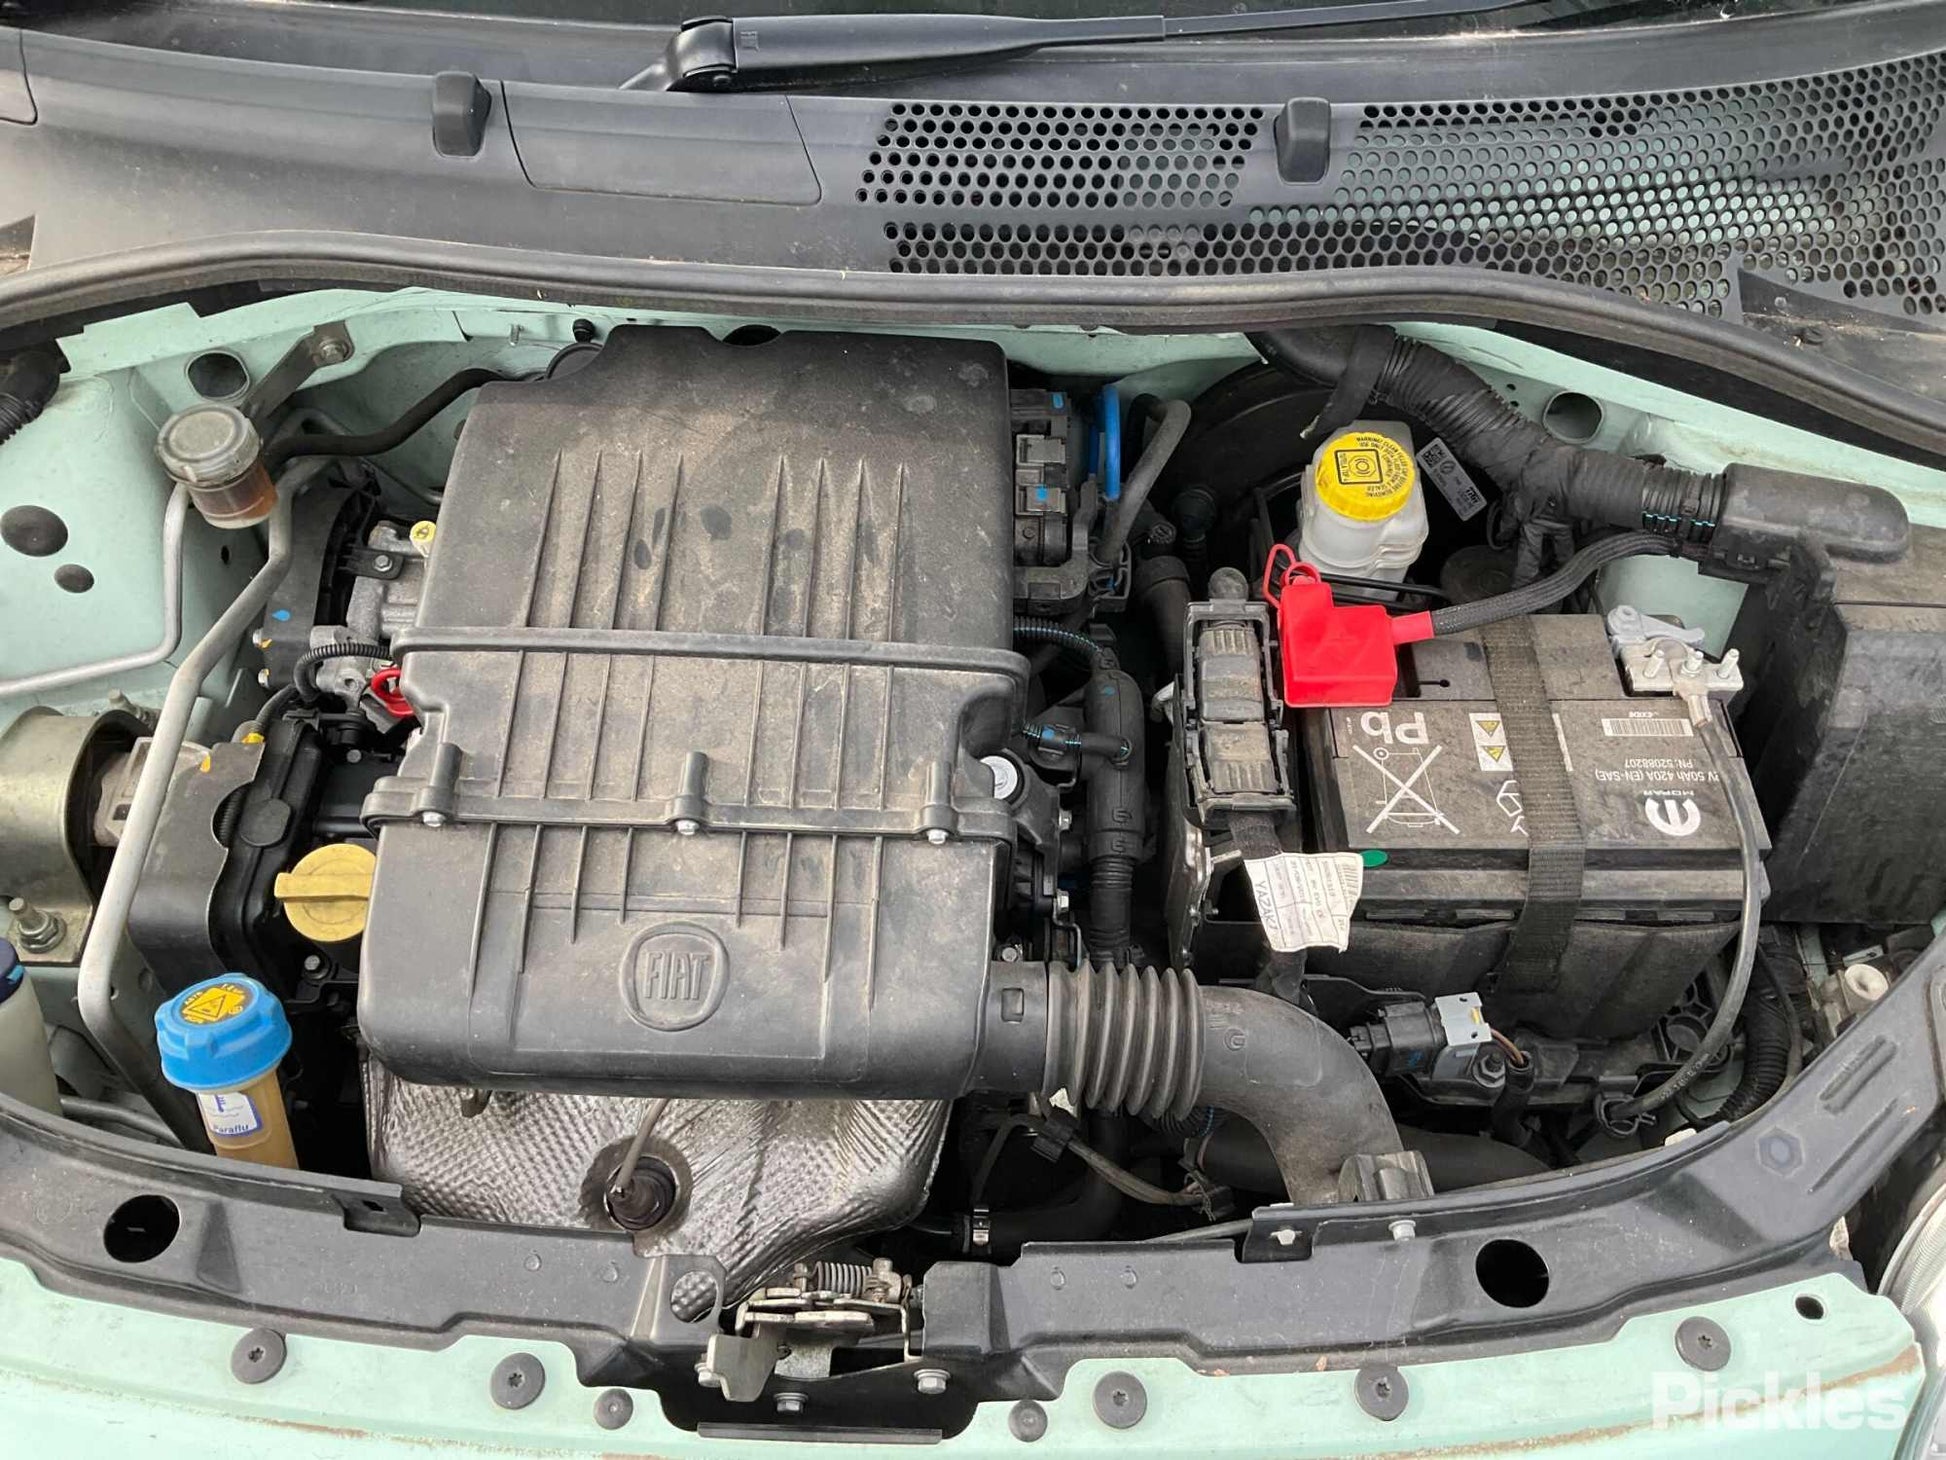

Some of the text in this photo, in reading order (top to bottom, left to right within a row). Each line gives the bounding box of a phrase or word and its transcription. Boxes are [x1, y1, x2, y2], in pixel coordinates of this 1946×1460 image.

[1361, 711, 1430, 744] Pb
[1594, 768, 1644, 784] (EN-SAE)
[1646, 770, 1674, 783] 420A
[1676, 770, 1706, 783] 50Ah
[1643, 789, 1695, 798] MOPAR
[644, 950, 709, 1002] FIAT
